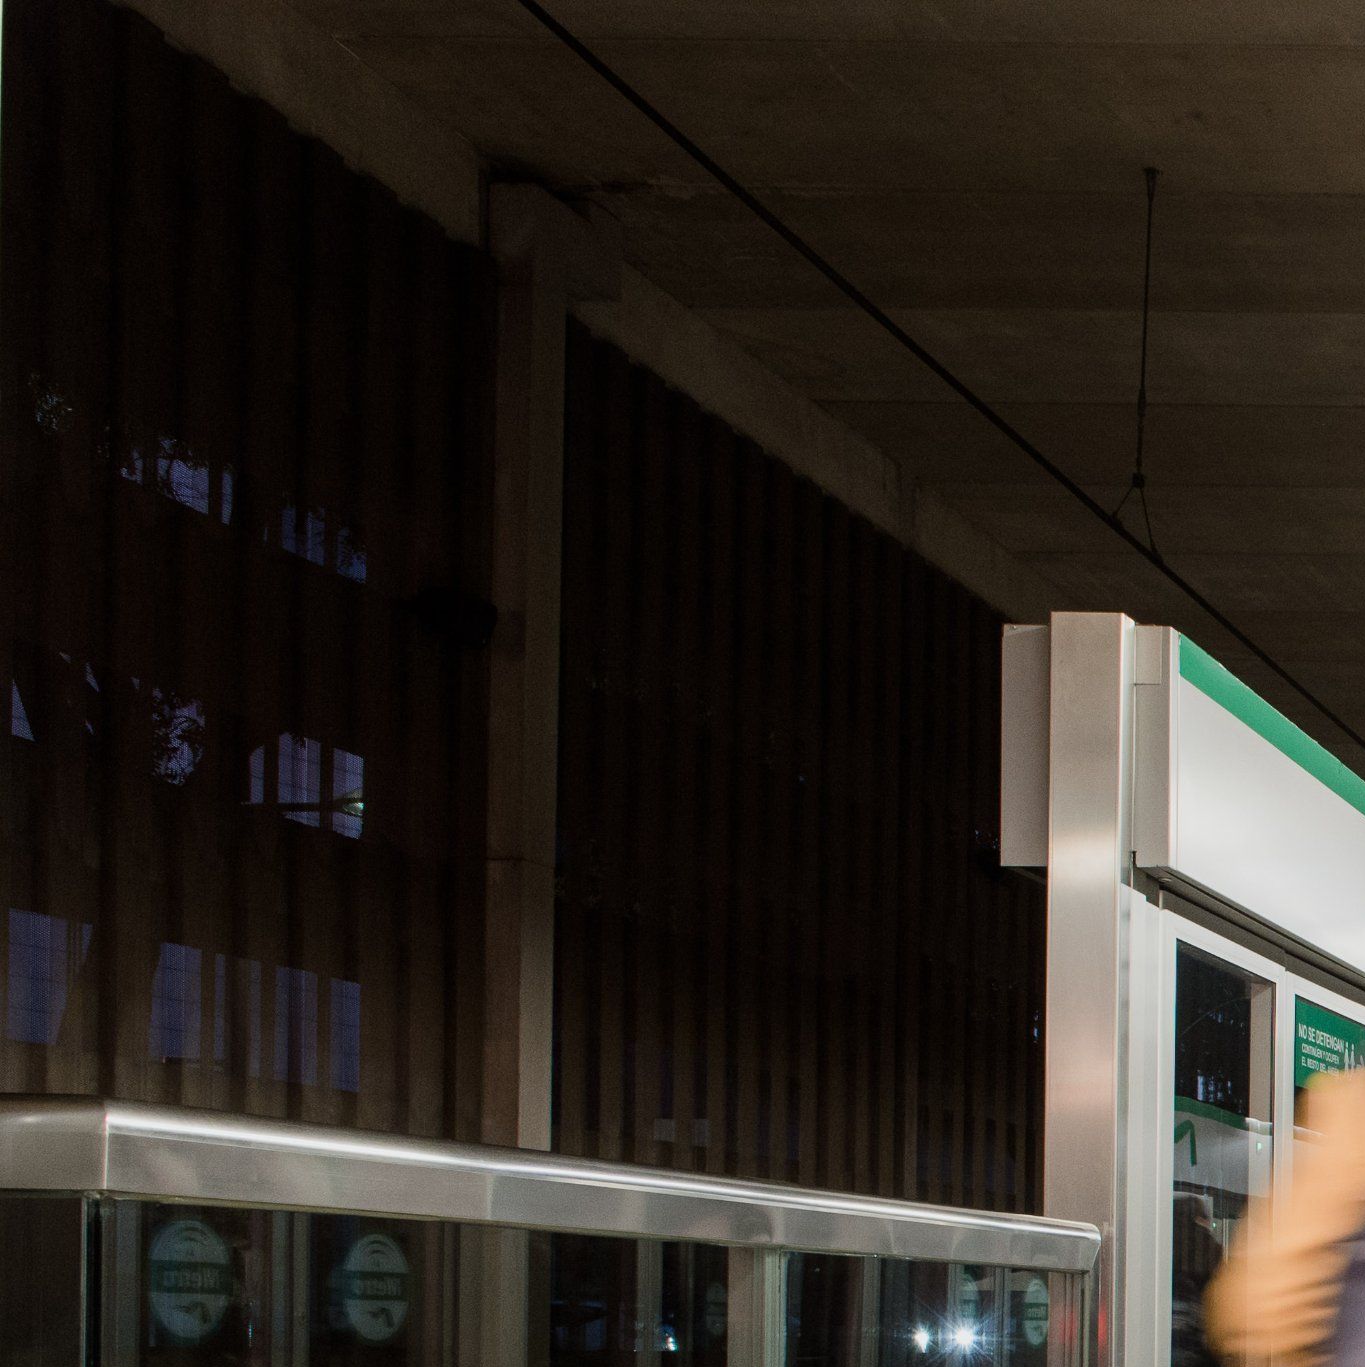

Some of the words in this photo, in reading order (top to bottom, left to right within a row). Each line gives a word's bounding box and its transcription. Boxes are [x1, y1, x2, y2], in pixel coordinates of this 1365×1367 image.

[1298, 1023, 1308, 1040] NO
[1307, 1026, 1316, 1043] SE
[1315, 1030, 1345, 1053] DETENGAN
